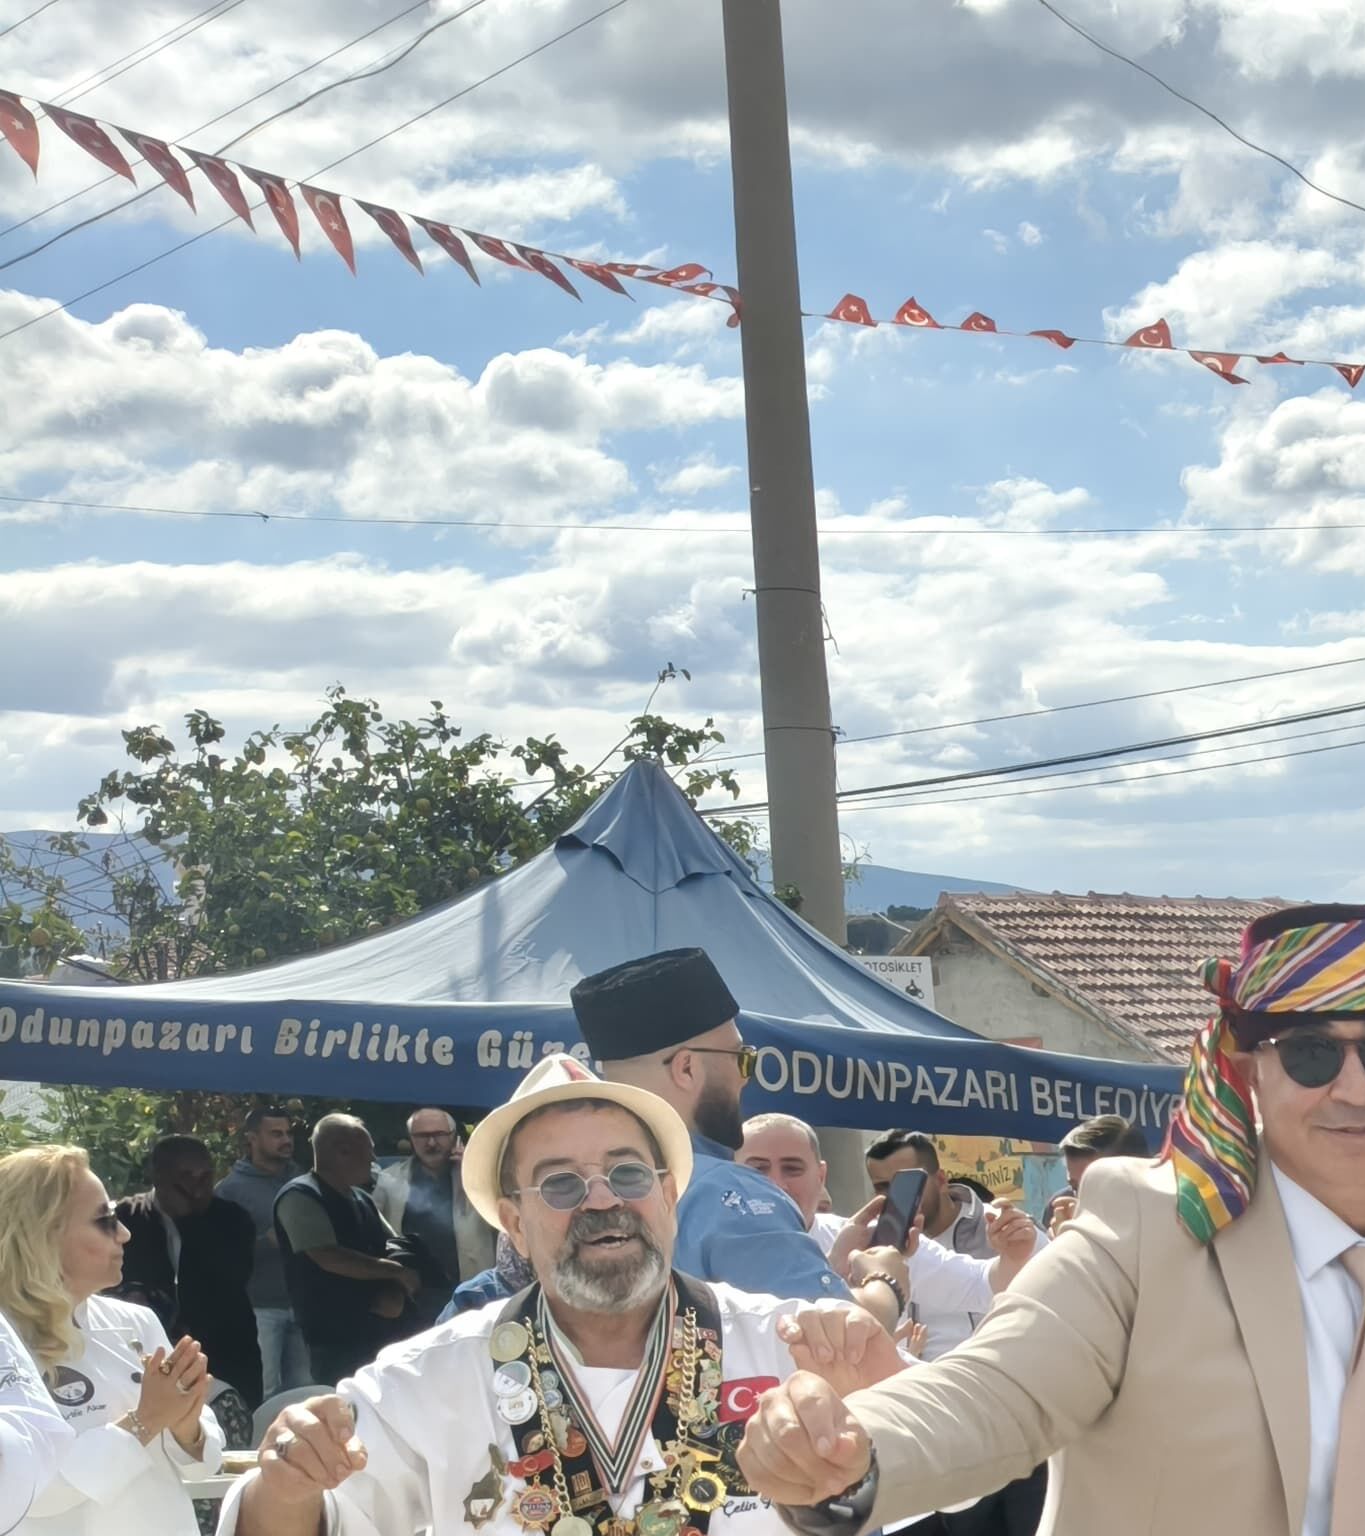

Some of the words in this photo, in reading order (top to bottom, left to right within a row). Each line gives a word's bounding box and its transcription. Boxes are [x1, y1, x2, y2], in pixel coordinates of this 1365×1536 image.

[864, 960, 922, 973] TOSİKLET
[0, 1006, 253, 1056] Odunpazarı
[274, 1018, 454, 1066] Birlikte
[477, 1029, 603, 1073] Güe
[755, 1046, 1019, 1112] ODUNPAZARI
[1030, 1076, 1184, 1128] BELEDİY
